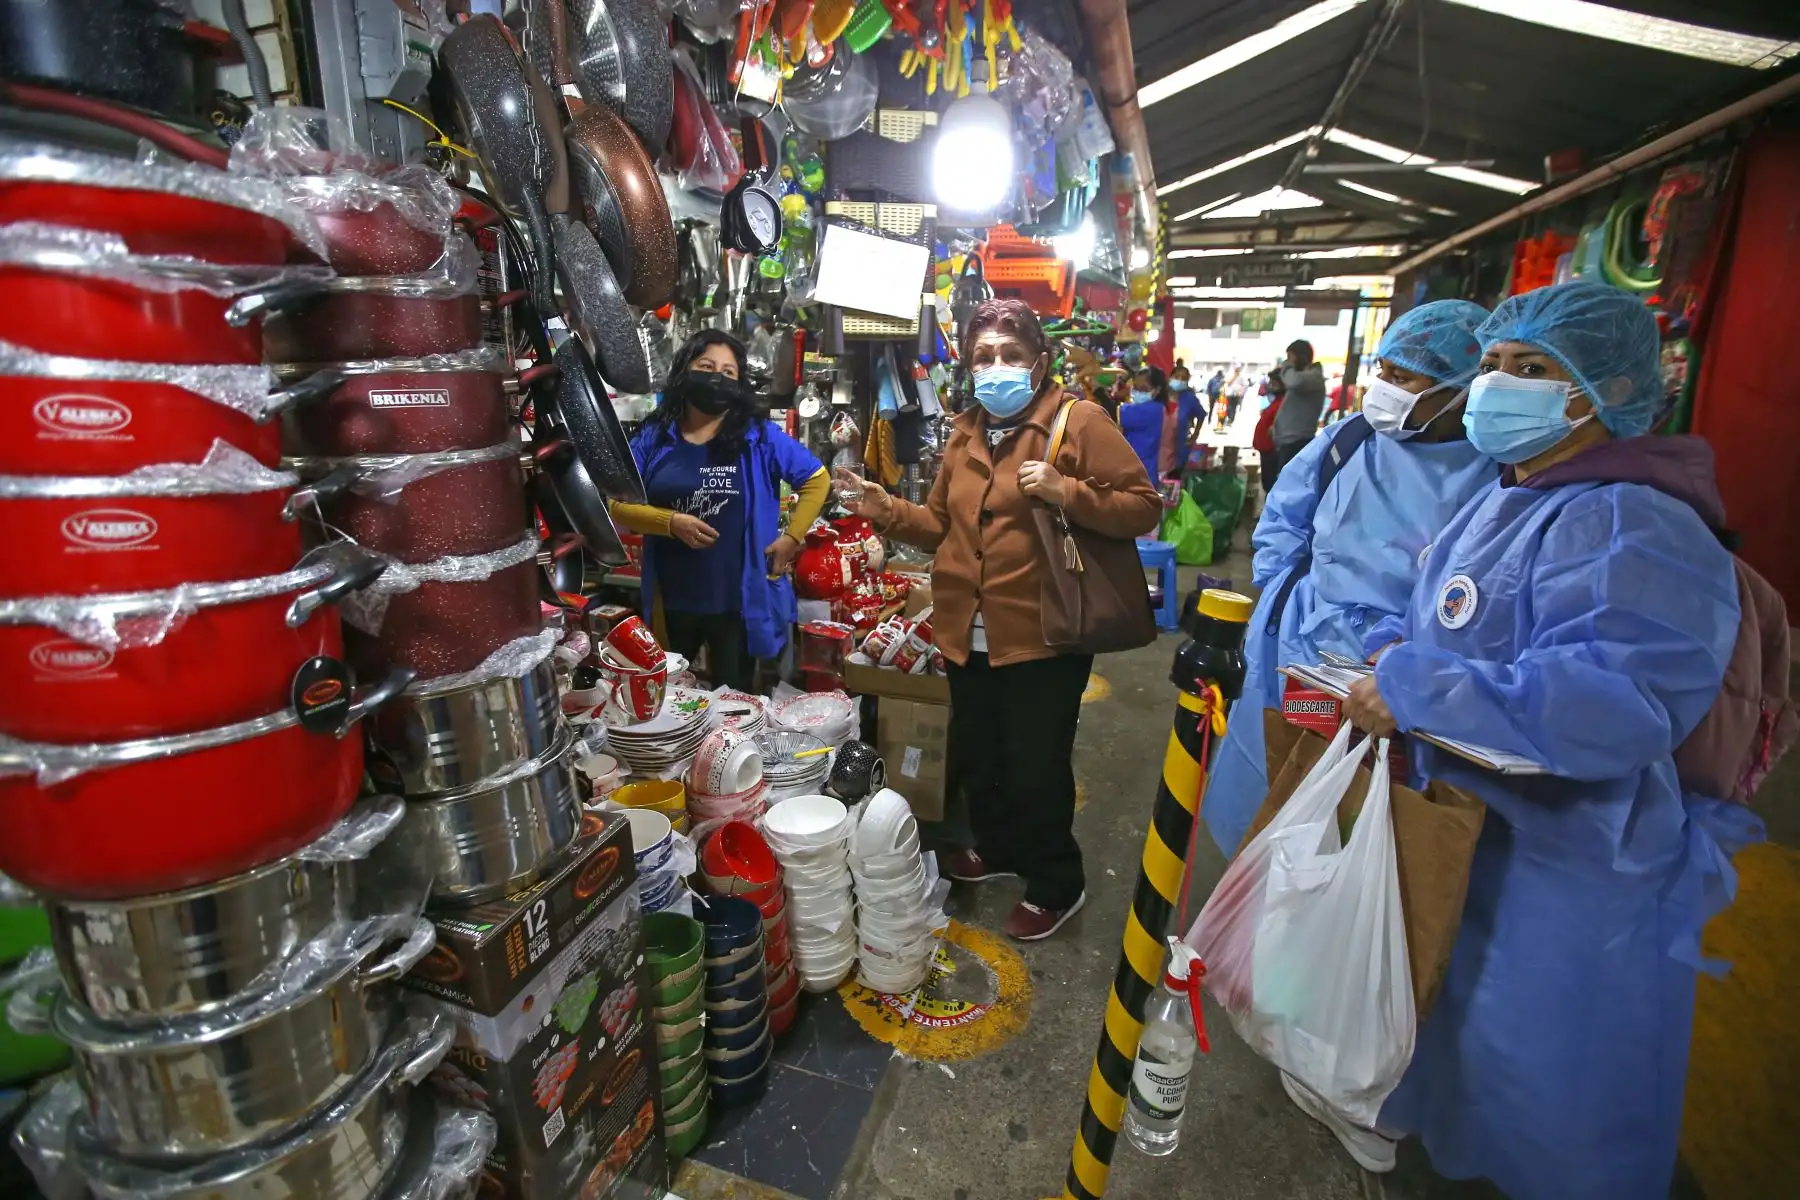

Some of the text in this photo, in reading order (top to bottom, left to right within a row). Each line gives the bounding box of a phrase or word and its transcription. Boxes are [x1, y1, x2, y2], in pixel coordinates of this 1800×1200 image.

[372, 393, 446, 406] BRIKENIA
[702, 478, 732, 488] LOVE
[1285, 700, 1336, 714] BIODESCARTE
[592, 875, 625, 910] CERAMICA
[523, 899, 549, 939] 12
[528, 928, 549, 954] PIEZAS
[530, 940, 551, 964] BLEND
